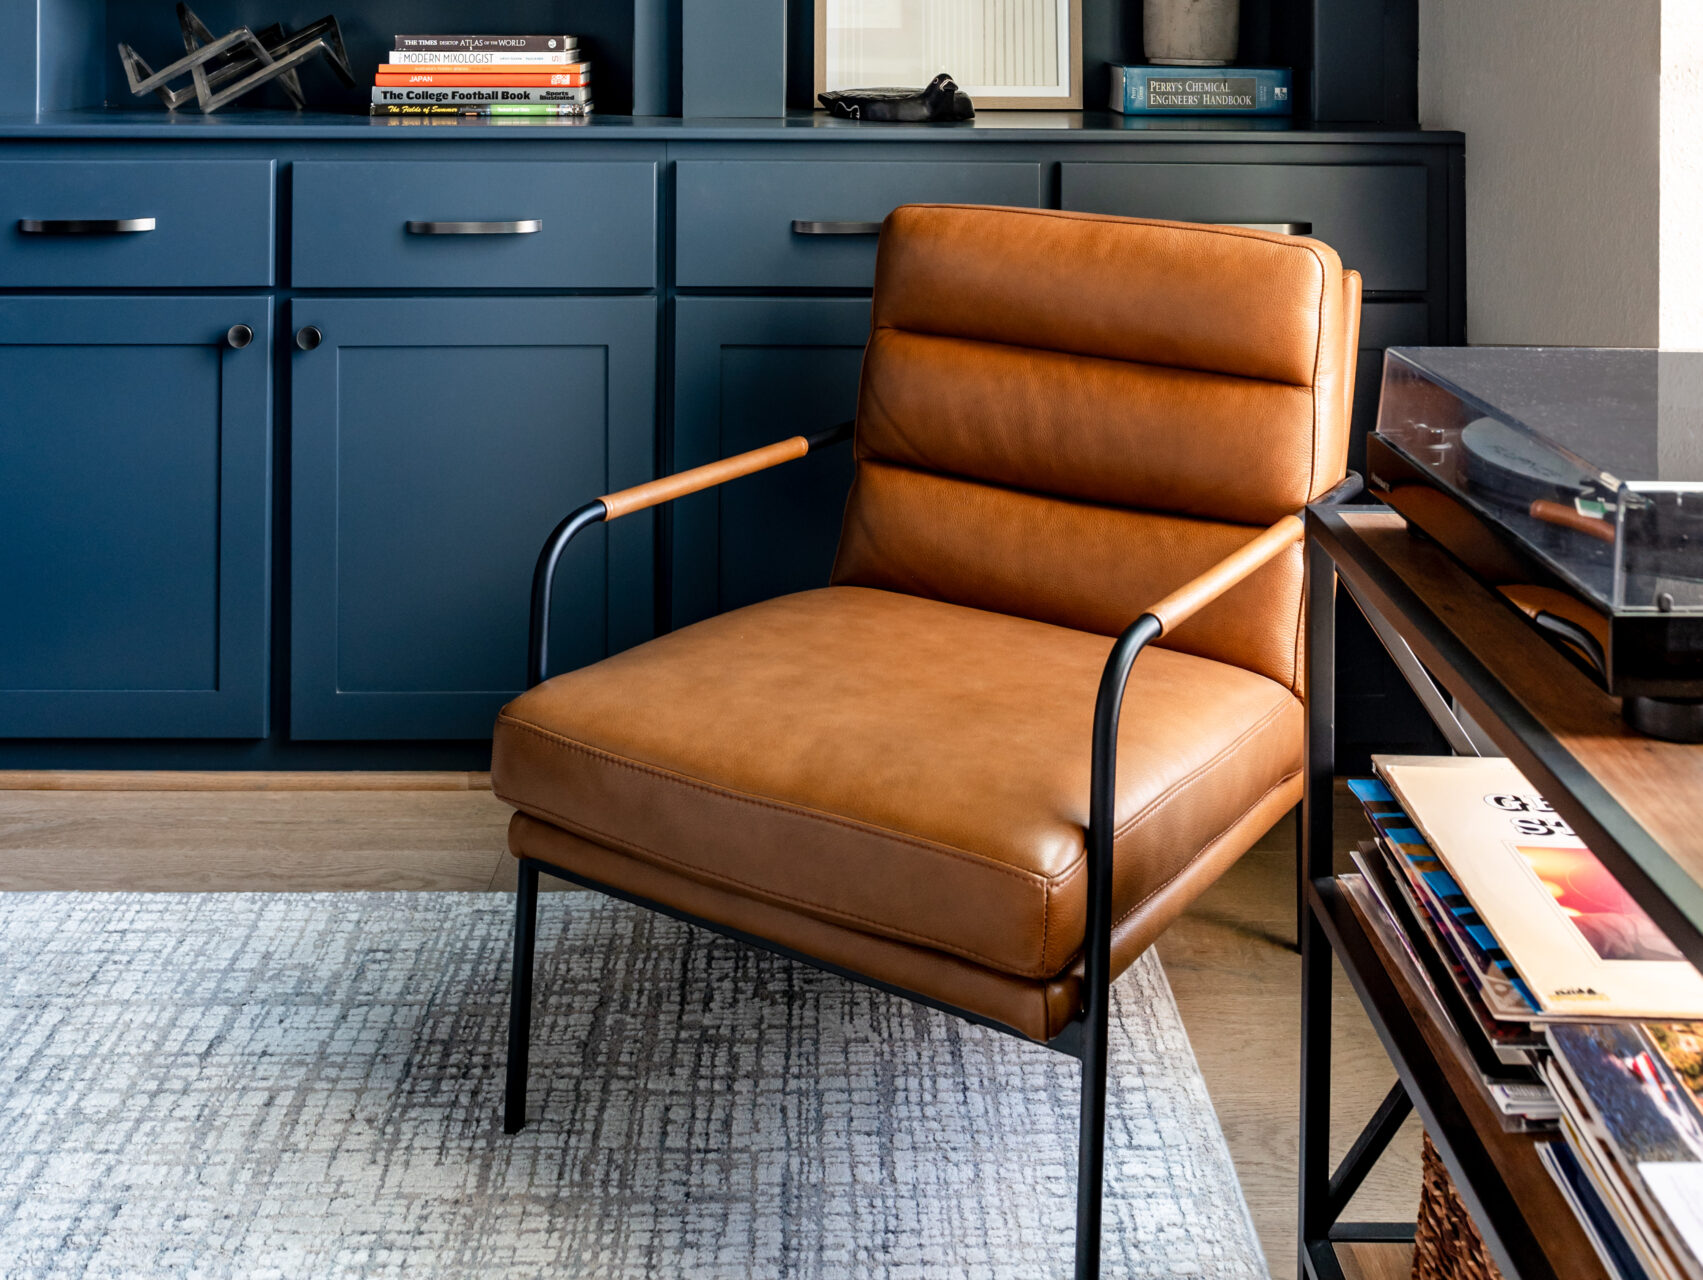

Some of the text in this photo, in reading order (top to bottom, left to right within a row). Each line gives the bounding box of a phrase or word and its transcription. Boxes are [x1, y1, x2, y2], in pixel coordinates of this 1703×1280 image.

[404, 54, 493, 63] MODERN MIXOLOGIST
[1150, 81, 1230, 92] PERRY'S CHEMICAL
[381, 91, 530, 102] The College Football Book
[1150, 94, 1252, 105] ENGINEERS' HANDBOOK
